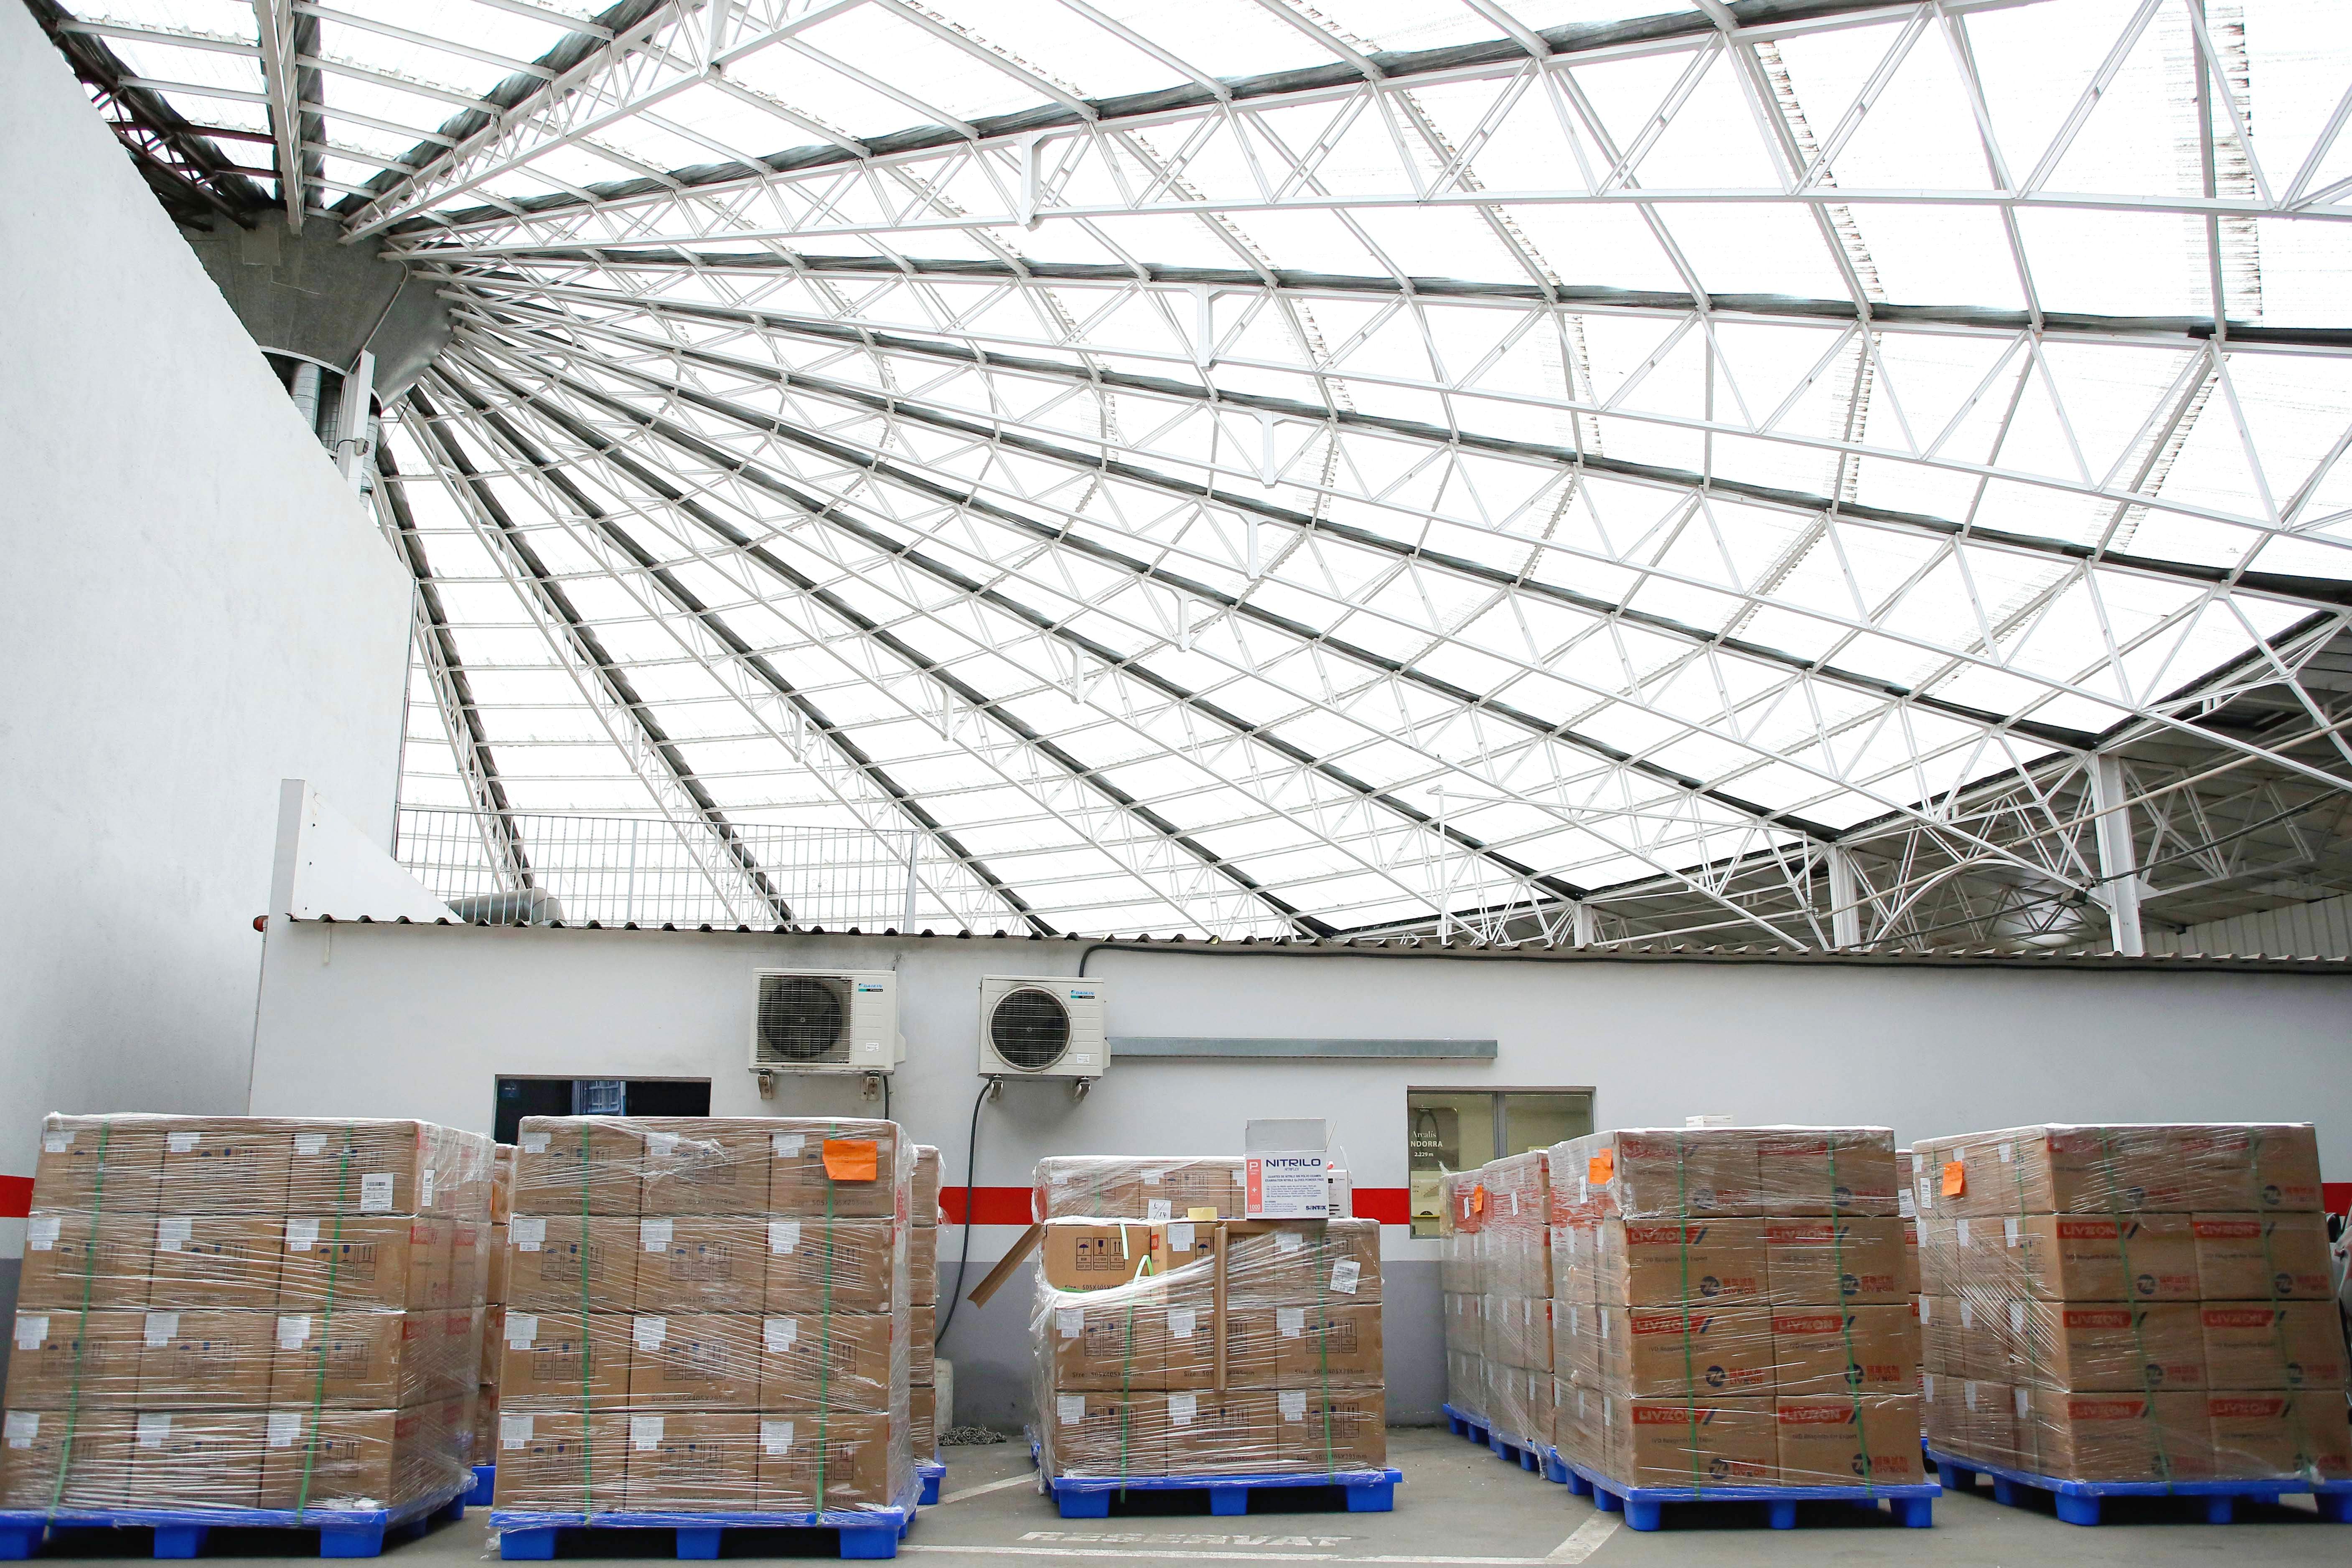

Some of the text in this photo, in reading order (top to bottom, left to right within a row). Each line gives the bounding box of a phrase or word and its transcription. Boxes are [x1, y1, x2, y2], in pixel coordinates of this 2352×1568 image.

[1266, 1159, 1321, 1167] NITRILO
[2063, 1226, 2116, 1235] LIVZON
[1778, 1319, 1833, 1330] LIVZON
[1017, 1531, 1353, 1547] RESERVAT
